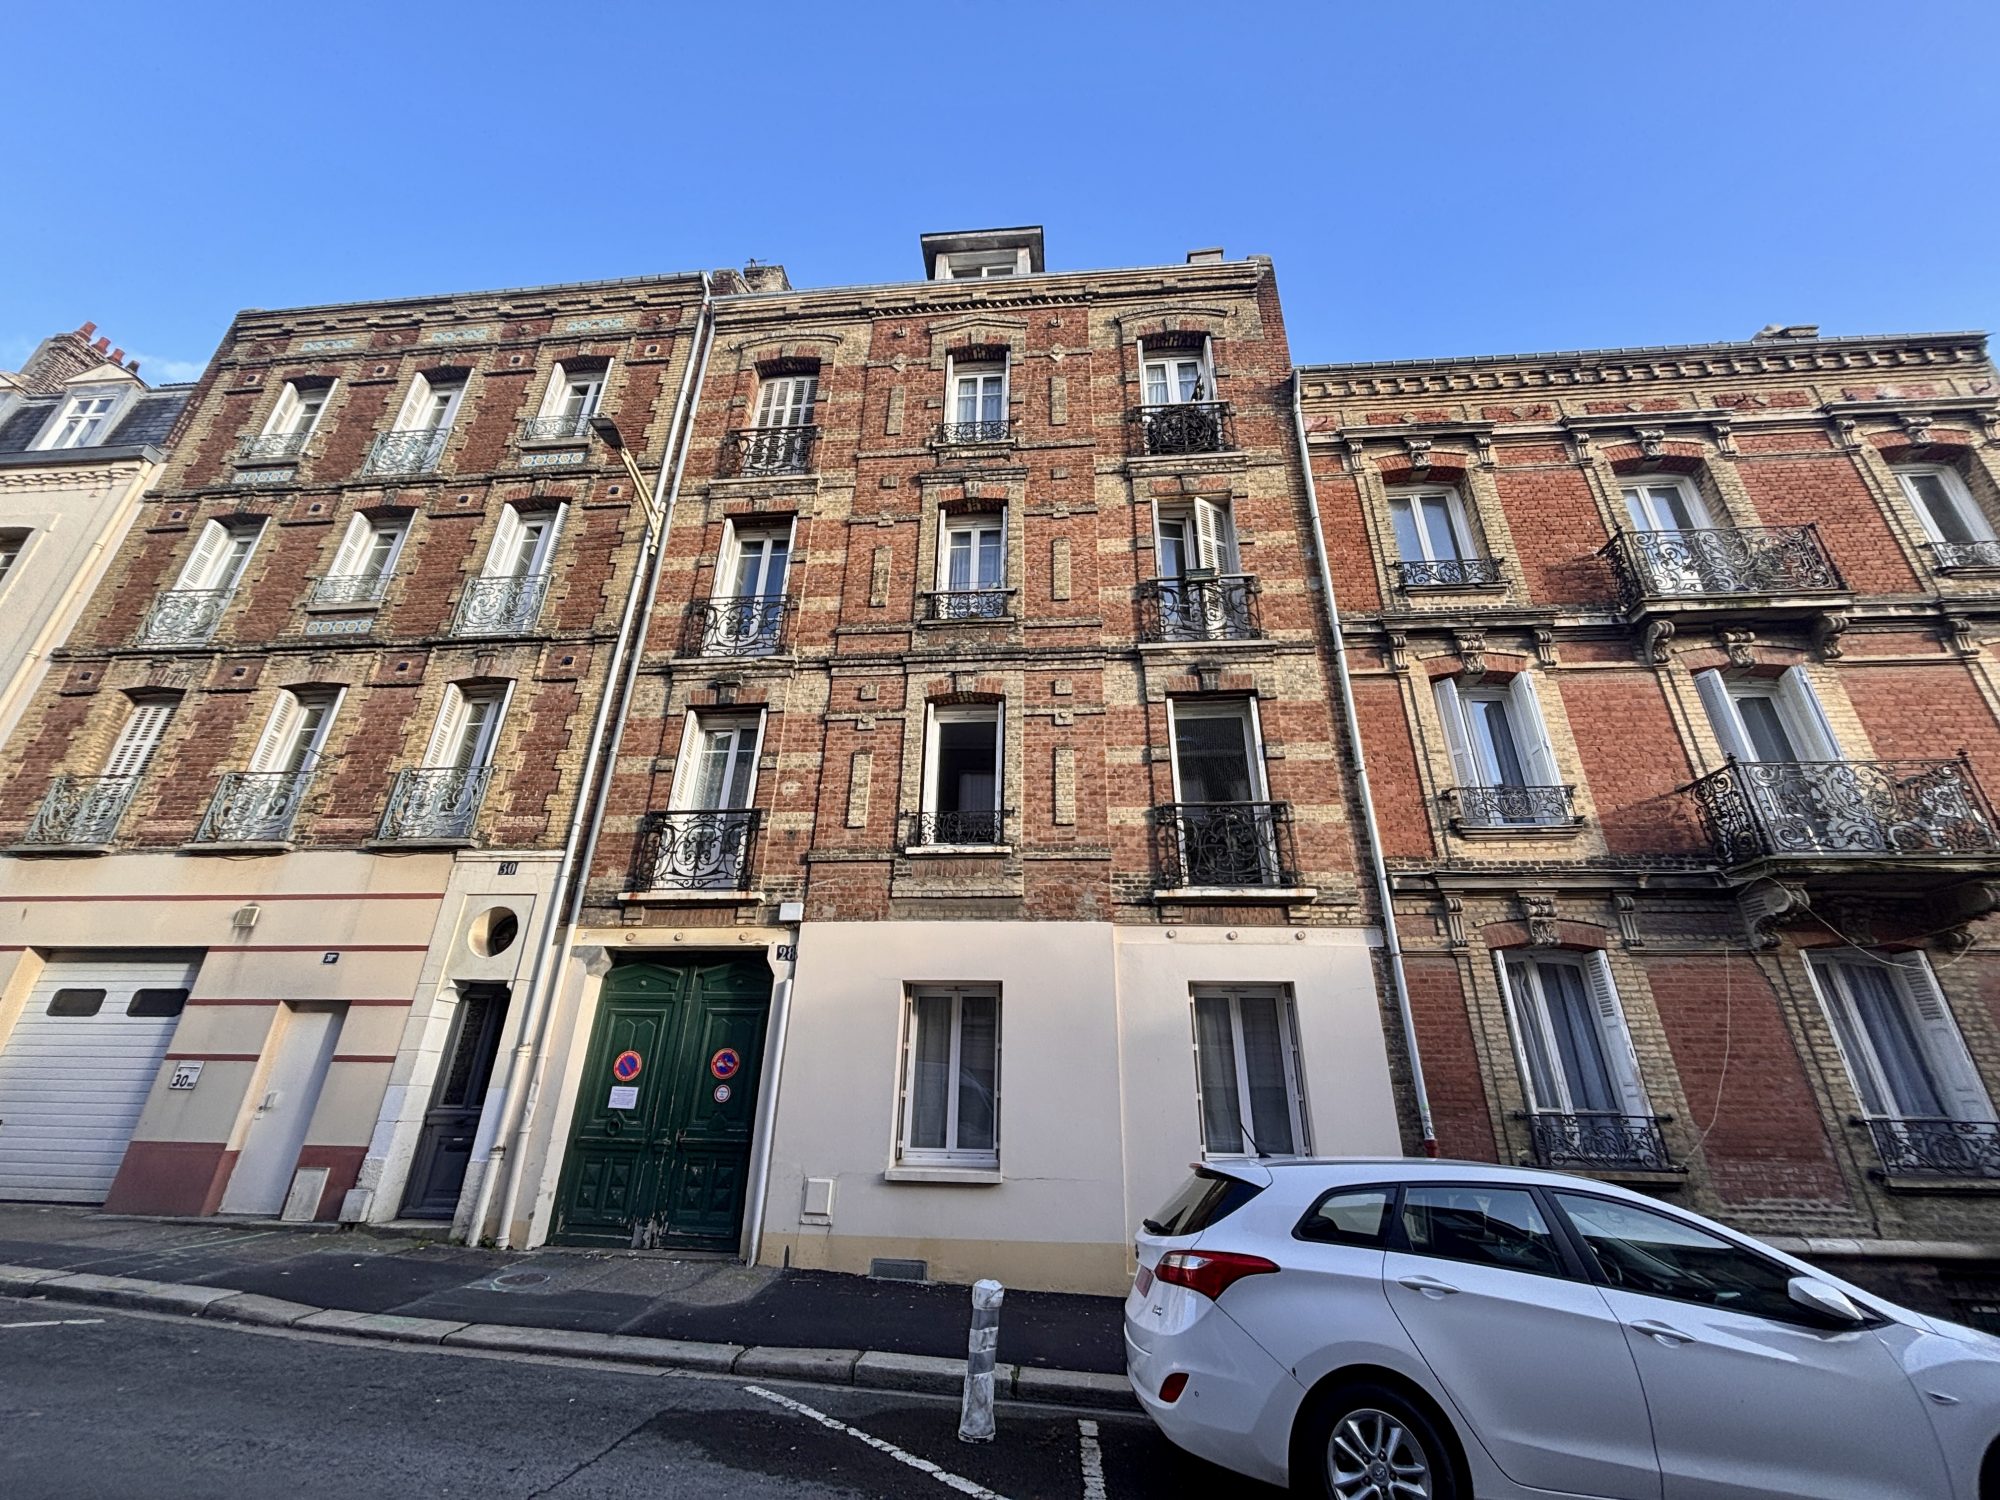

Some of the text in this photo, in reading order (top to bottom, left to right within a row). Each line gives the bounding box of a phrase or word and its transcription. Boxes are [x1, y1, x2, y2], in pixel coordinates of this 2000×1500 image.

[499, 862, 516, 875] 30
[778, 946, 795, 960] 28
[171, 1074, 189, 1087] 30
